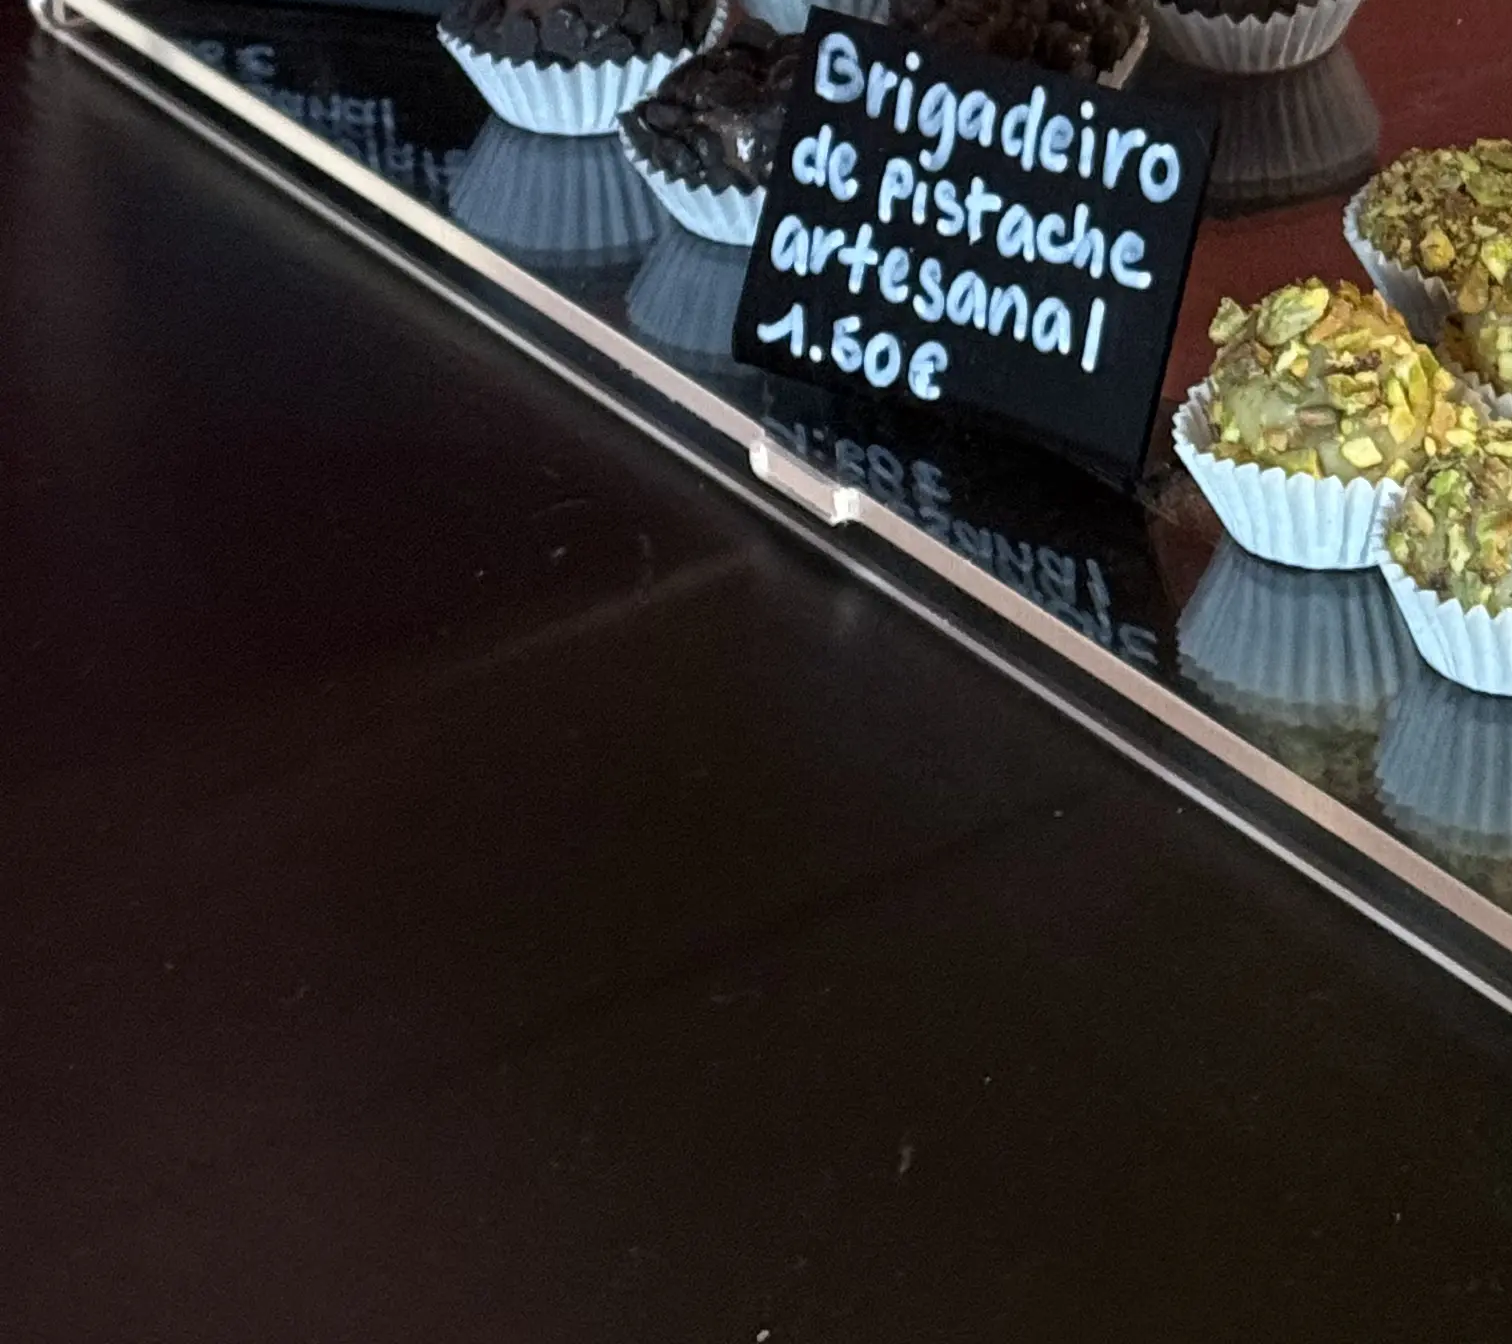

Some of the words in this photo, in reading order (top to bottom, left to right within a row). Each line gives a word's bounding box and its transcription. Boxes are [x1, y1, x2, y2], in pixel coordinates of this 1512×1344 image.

[791, 124, 859, 200] de
[815, 32, 1181, 202] Brigadeiro
[771, 215, 1106, 372] artesanal
